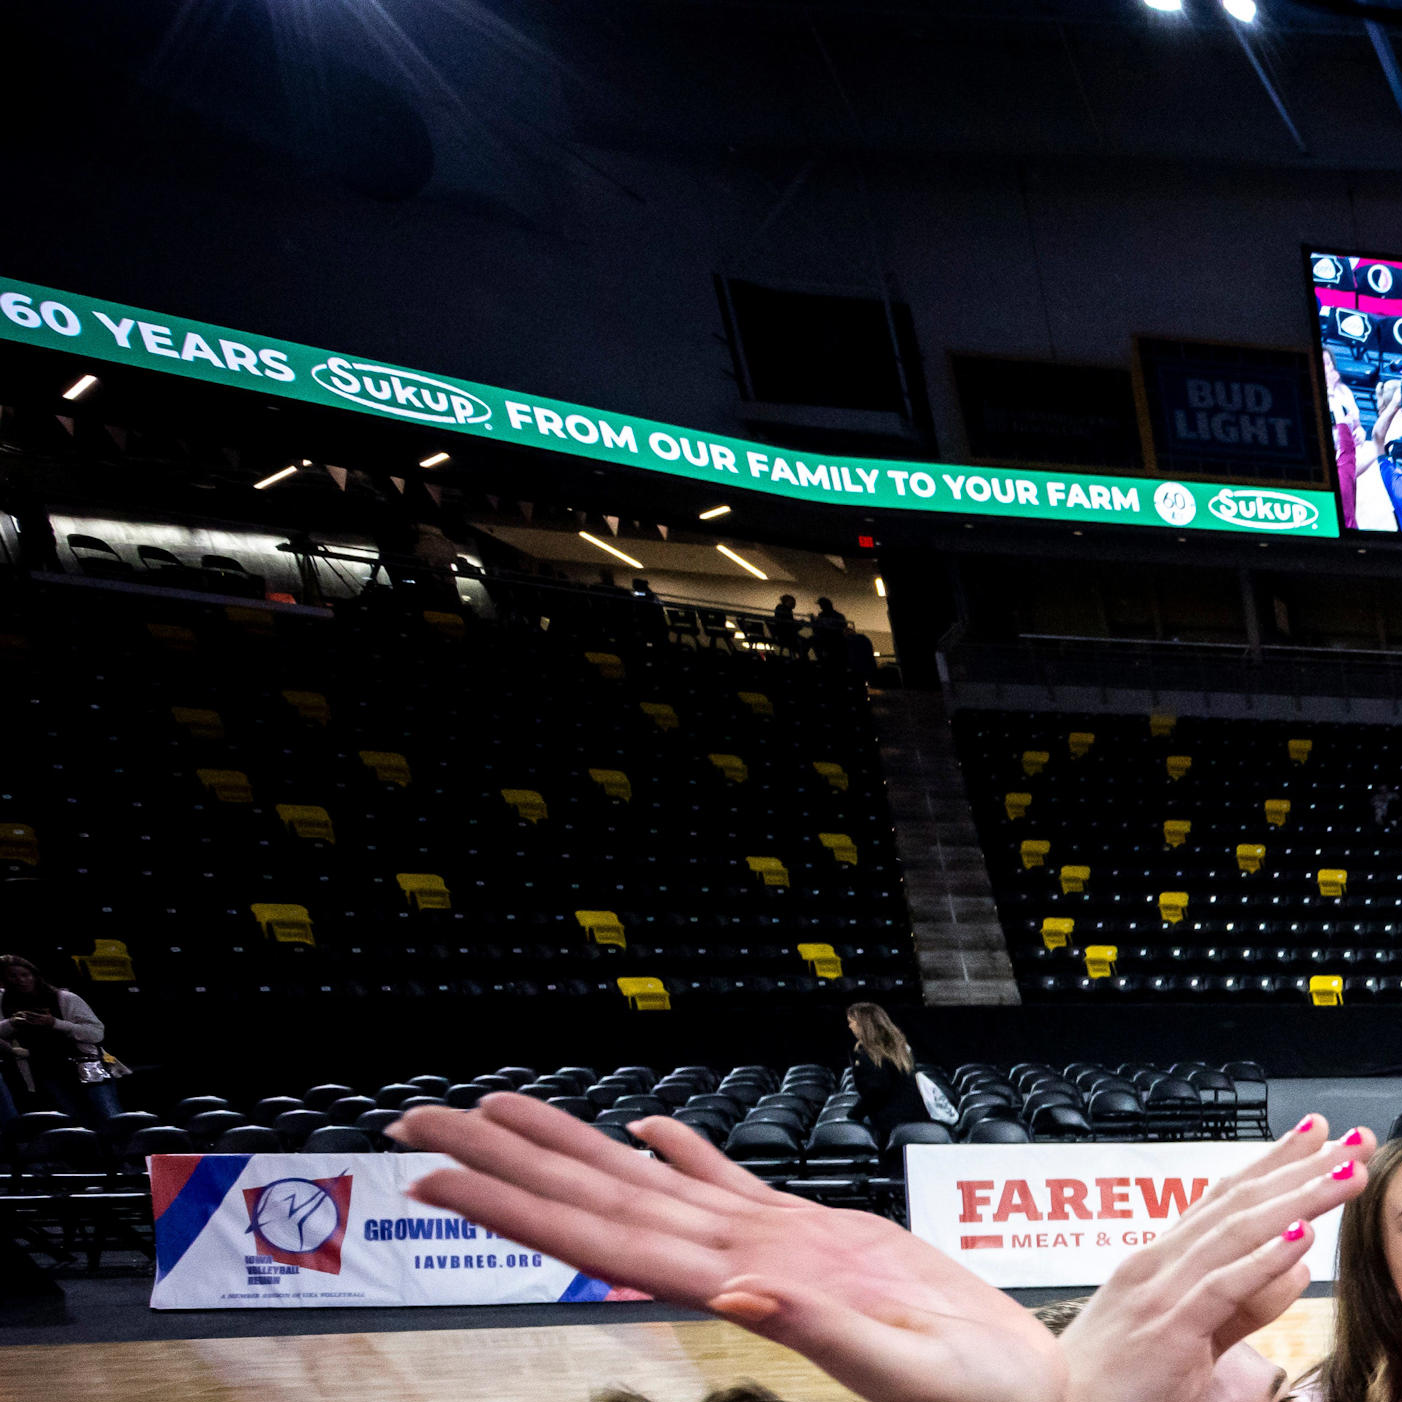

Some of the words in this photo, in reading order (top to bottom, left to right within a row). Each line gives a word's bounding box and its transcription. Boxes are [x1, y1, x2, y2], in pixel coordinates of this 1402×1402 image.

[0, 292, 81, 337] 60
[92, 310, 297, 383] YEARS
[327, 356, 476, 424] Sukup
[504, 400, 639, 453] FROM
[648, 431, 740, 474] OUR
[747, 451, 879, 495] FAMILY
[887, 469, 937, 498] TO
[942, 474, 1039, 507] YOUR
[1047, 480, 1140, 513] FARM
[1219, 492, 1309, 526] Sukup
[1185, 377, 1273, 414] BUD
[1174, 410, 1294, 448] LIGHT
[956, 1177, 1210, 1224] FAREW
[364, 1218, 478, 1242] GROWING
[1011, 1232, 1085, 1249] MEAT
[1096, 1232, 1113, 1248] &
[246, 1266, 300, 1275] VOLLEYBALL
